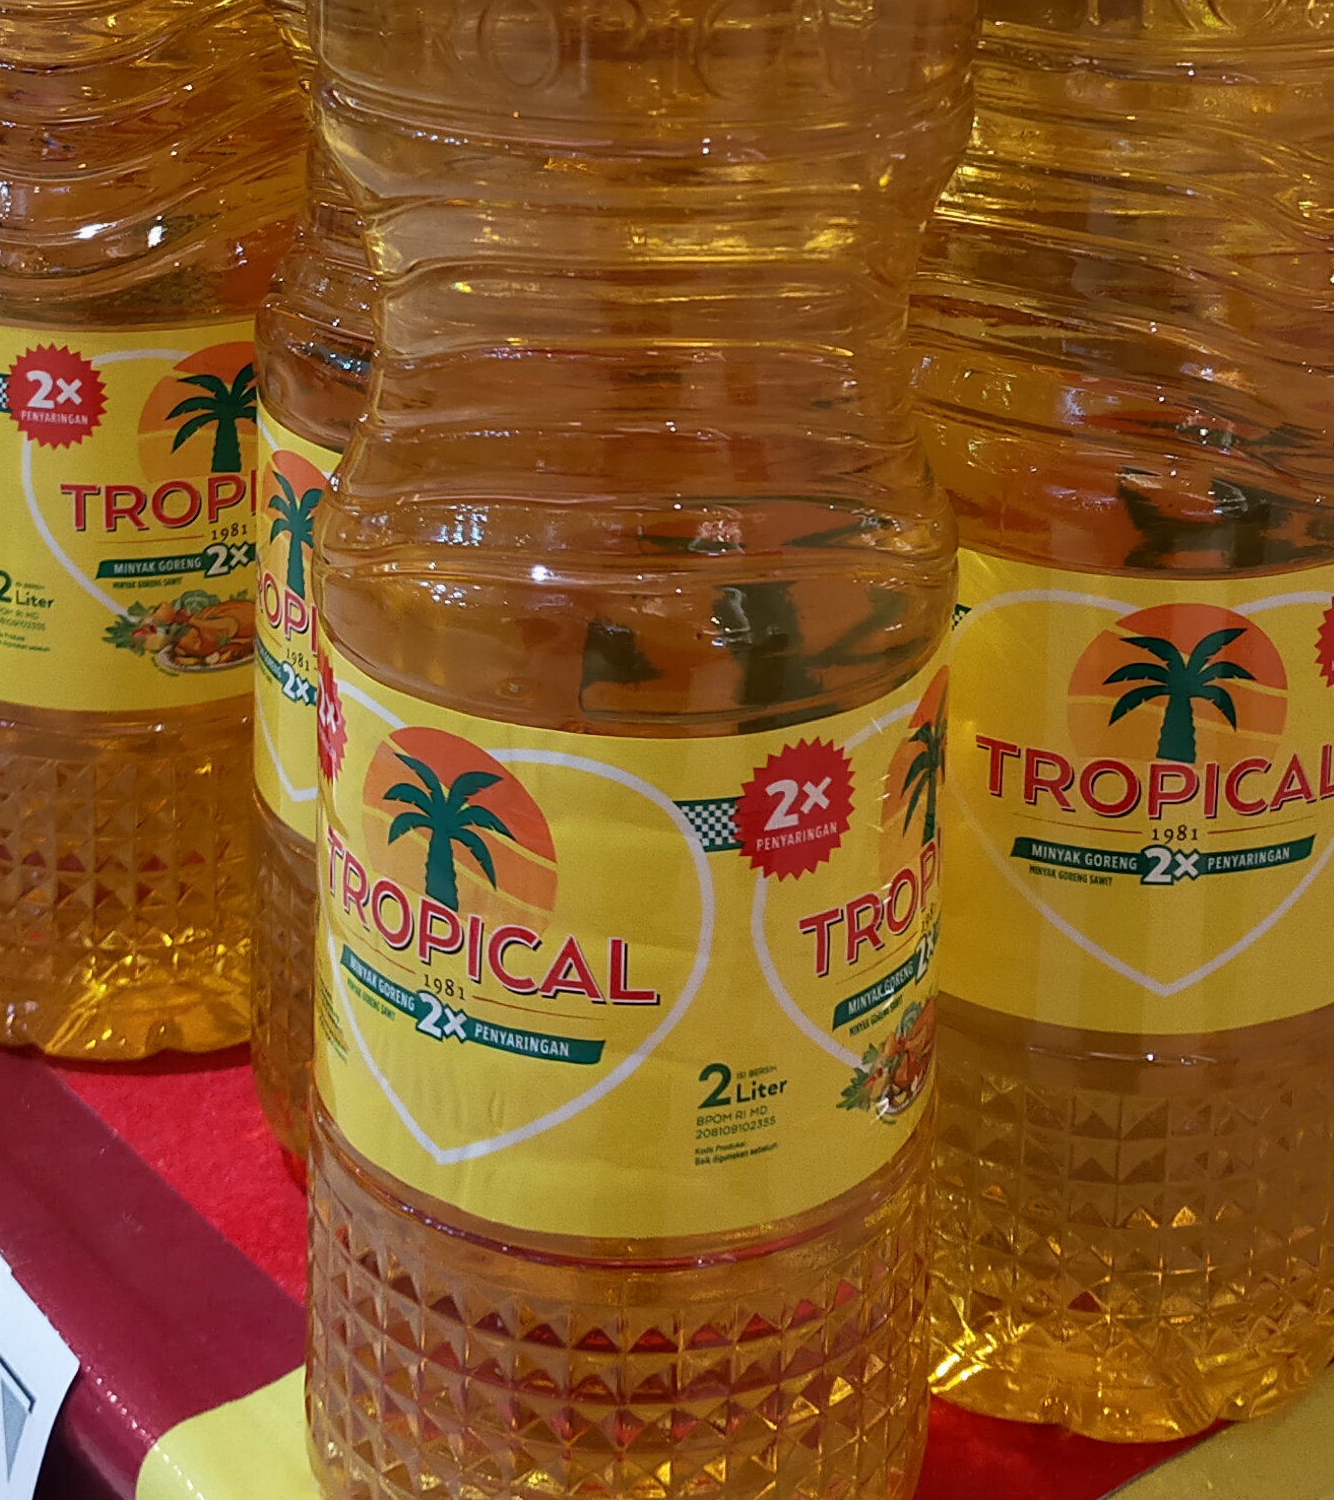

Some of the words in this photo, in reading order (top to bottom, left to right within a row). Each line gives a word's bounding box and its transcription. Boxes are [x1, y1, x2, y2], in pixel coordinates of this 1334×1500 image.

[24, 368, 84, 410] 2X
[20, 409, 89, 426] PENYARINGAN
[210, 522, 248, 543] 1981
[113, 561, 157, 575] MINYAK
[158, 556, 202, 573] GORENG
[204, 543, 250, 578] 2X
[15, 589, 55, 610] Liter
[286, 648, 310, 672] 1981
[281, 662, 310, 704] 2X
[763, 775, 833, 832] 2X
[755, 821, 839, 852] PENYARINGAN
[1152, 824, 1199, 844] 1981
[1031, 843, 1081, 865] MINYAK
[1085, 852, 1138, 871] GORENG
[1142, 846, 1200, 884] 2X
[1207, 846, 1291, 871] PENYARINGAN
[325, 823, 661, 1006] TROPICAL
[422, 972, 467, 1001] 1981
[847, 987, 884, 1016] MINYAK
[882, 961, 915, 999] GORENG
[348, 952, 379, 988] MINYAK
[376, 976, 416, 1013] GORENG
[417, 991, 468, 1041] 2X
[474, 1022, 570, 1058] PENYARINGAN
[697, 1062, 732, 1110] 2
[736, 1079, 788, 1104] Liter
[696, 1112, 733, 1127] BPOM
[735, 1109, 747, 1121] RI
[750, 1105, 769, 1118] MD
[695, 1156, 712, 1167] Baik
